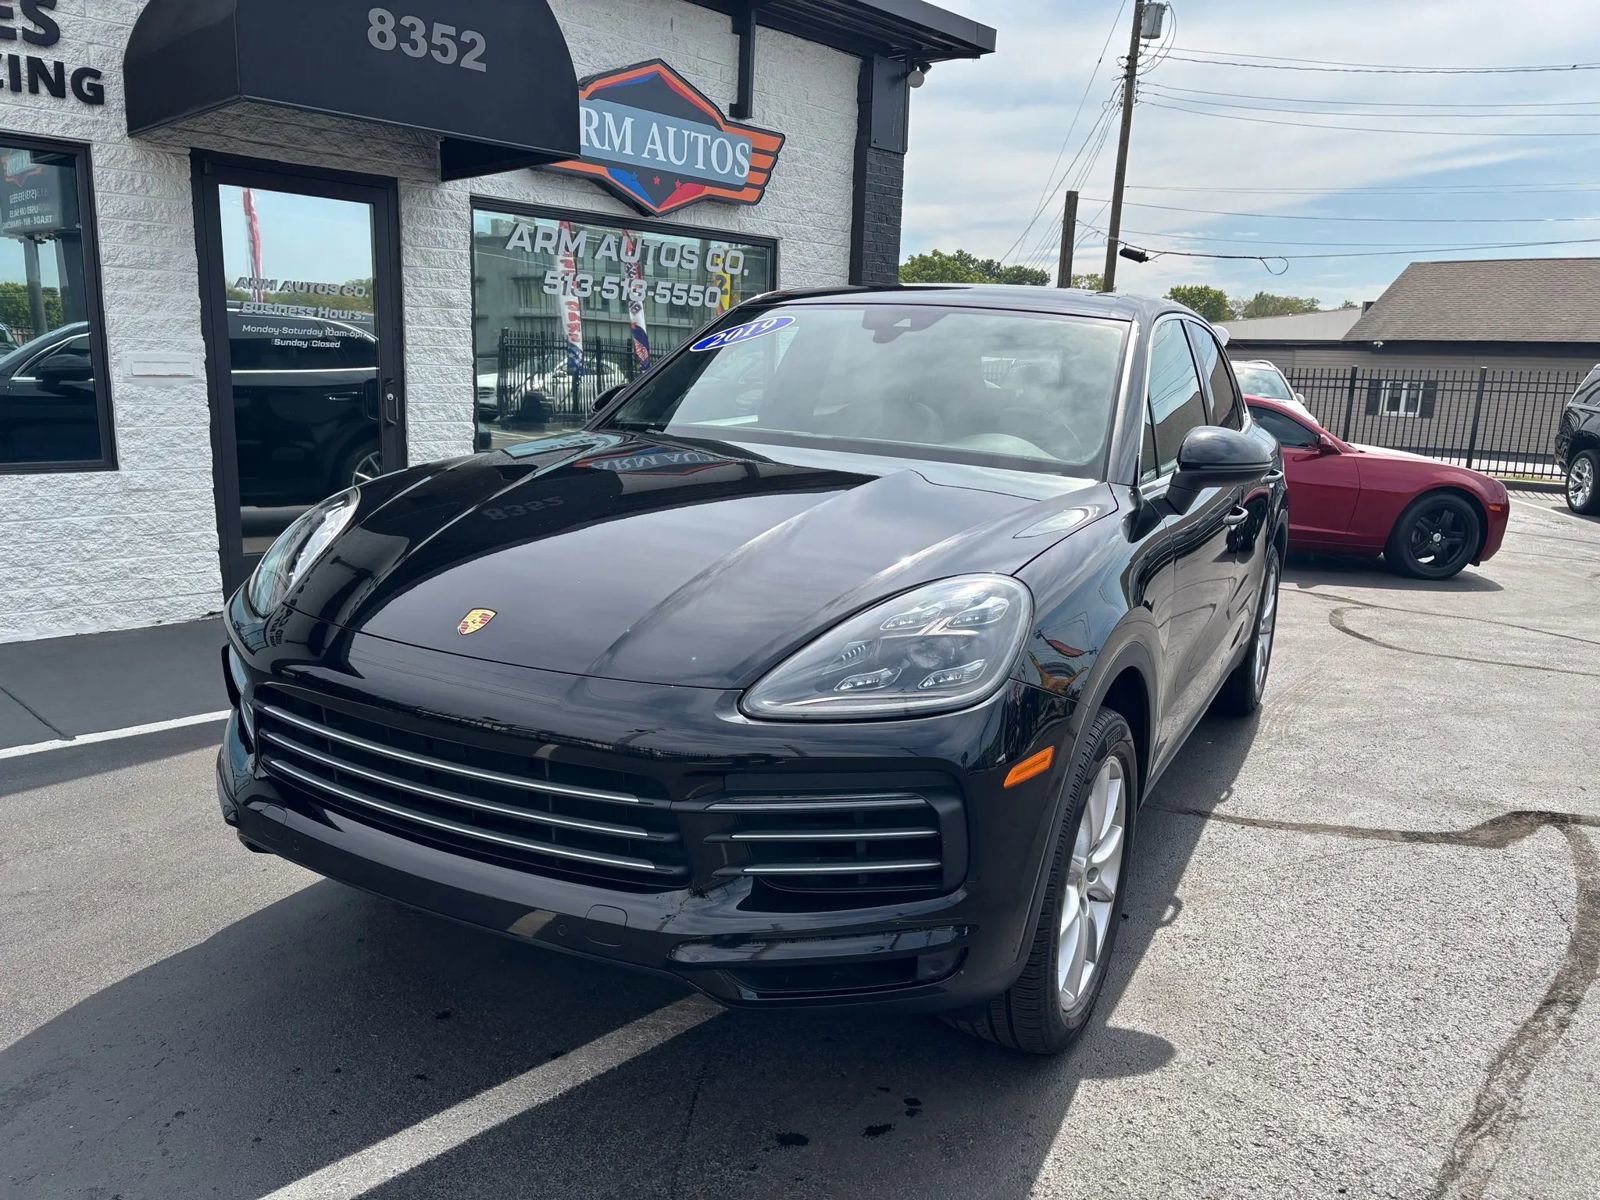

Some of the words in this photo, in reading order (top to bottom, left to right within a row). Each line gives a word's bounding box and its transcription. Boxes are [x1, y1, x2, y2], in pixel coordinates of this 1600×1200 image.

[367, 7, 487, 72] 8352
[641, 122, 750, 178] AUTOS
[506, 222, 587, 258] ARM
[595, 233, 699, 270] AUTOS
[705, 247, 749, 276] CO.
[235, 276, 278, 291] ARM
[279, 279, 340, 296] AUTOS
[341, 284, 369, 298] CO.
[543, 270, 722, 309] 513-513-5550
[242, 302, 316, 318] Business
[242, 324, 323, 337] Monday-Saturday
[274, 338, 308, 349] Sunday
[311, 340, 341, 349] Closed
[705, 319, 777, 348] 2019
